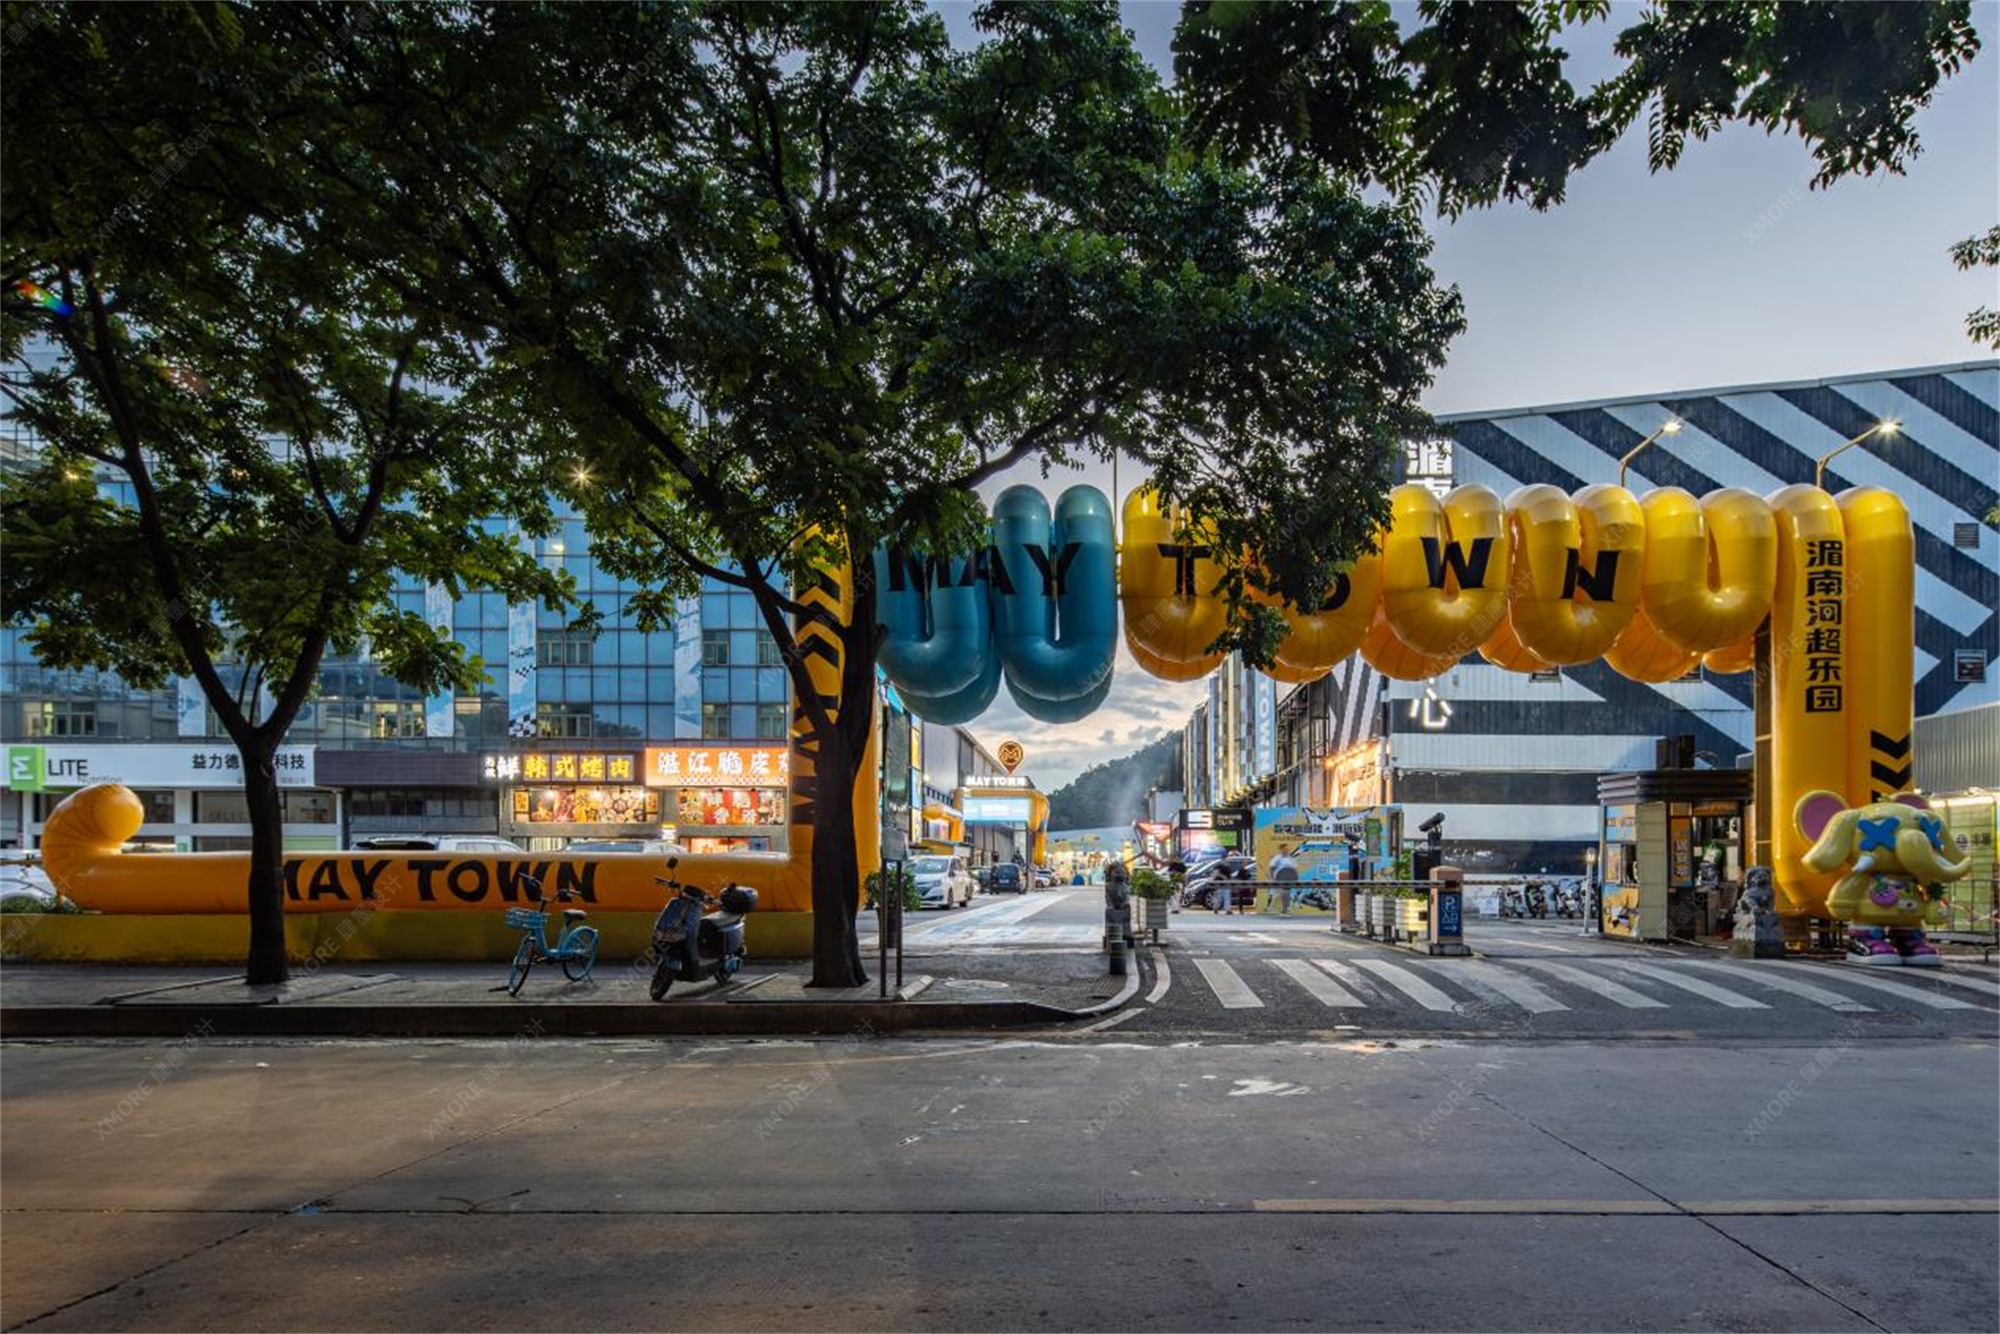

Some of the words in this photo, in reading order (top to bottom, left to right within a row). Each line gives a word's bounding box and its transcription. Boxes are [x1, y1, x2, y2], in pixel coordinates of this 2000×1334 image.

[1409, 687, 1454, 729] 心
[192, 753, 306, 770] 益力德科技
[966, 775, 990, 786] MAY
[408, 858, 598, 902] TOWN
